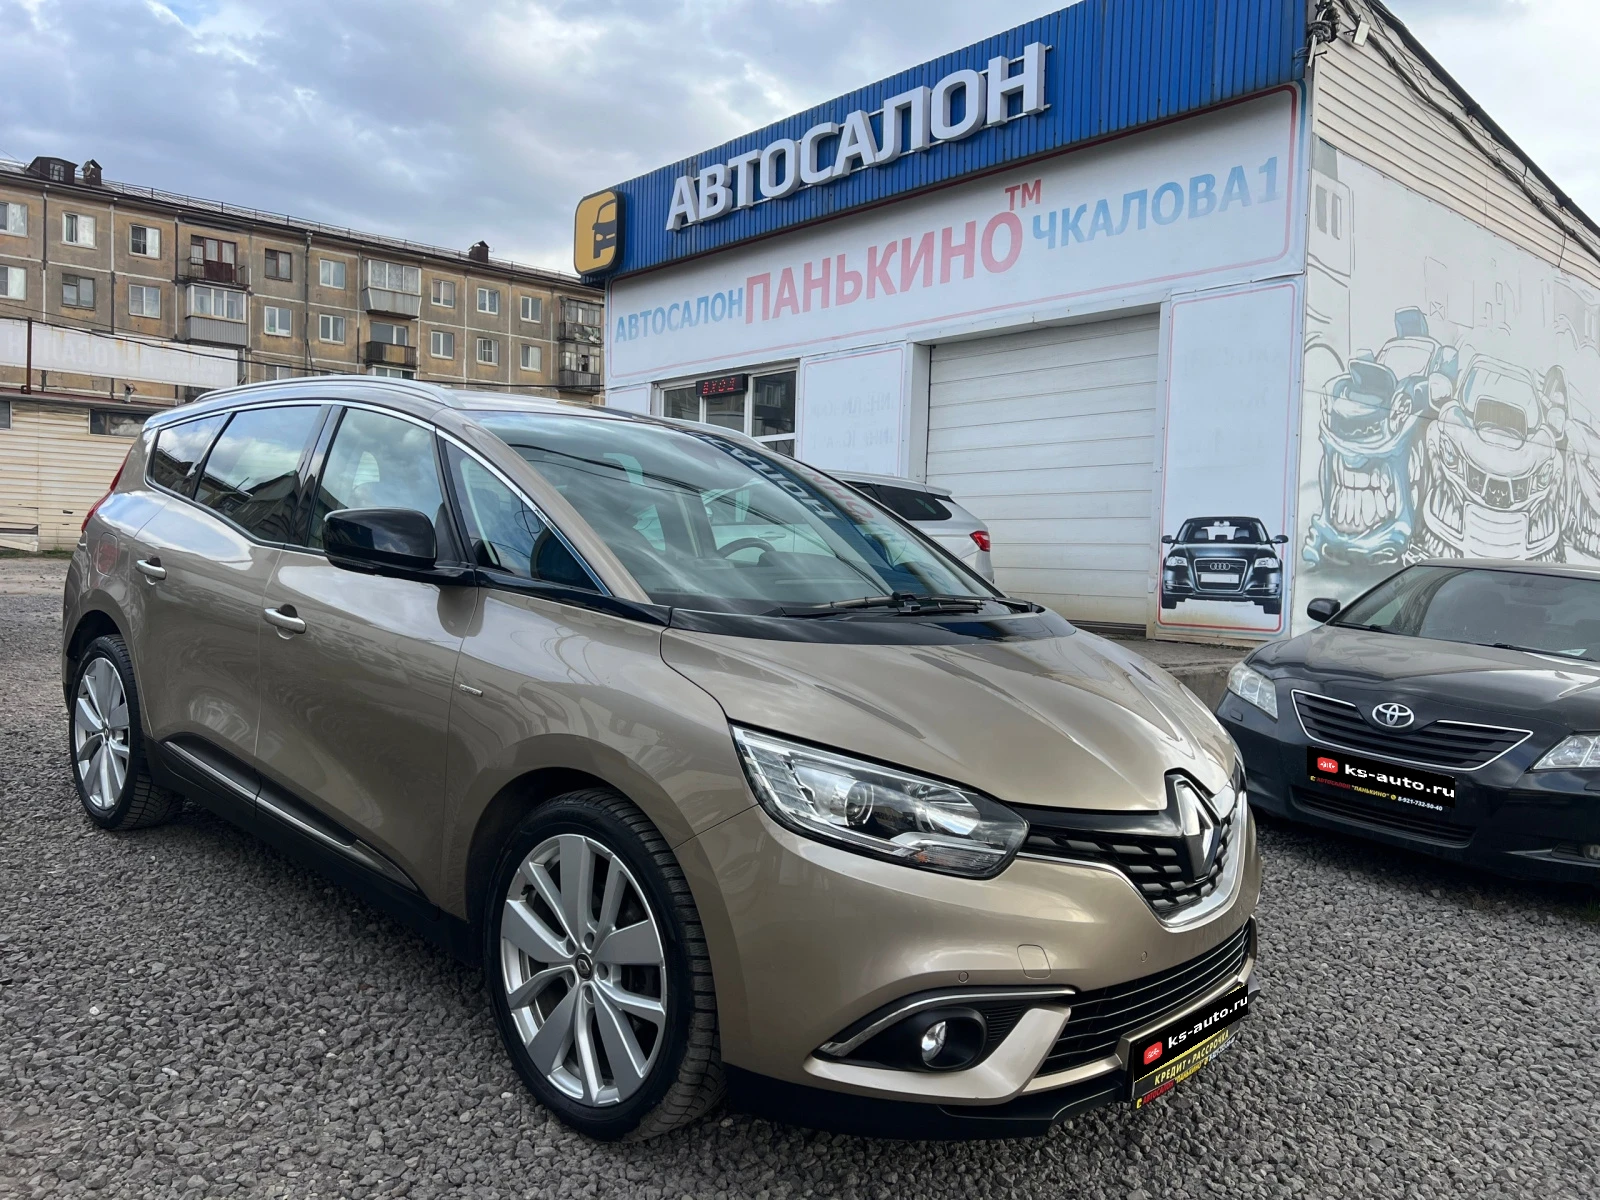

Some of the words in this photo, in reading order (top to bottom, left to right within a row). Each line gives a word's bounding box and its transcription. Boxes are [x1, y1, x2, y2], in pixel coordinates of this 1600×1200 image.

[665, 41, 1046, 232] АВТОСАЛОН
[614, 286, 743, 343] АВТОСАЛОН
[744, 211, 1024, 325] ПАНЬКИНО
[1154, 1059, 1187, 1086] КРЕДИТ
[1191, 1029, 1229, 1064] РАССРОЧКА
